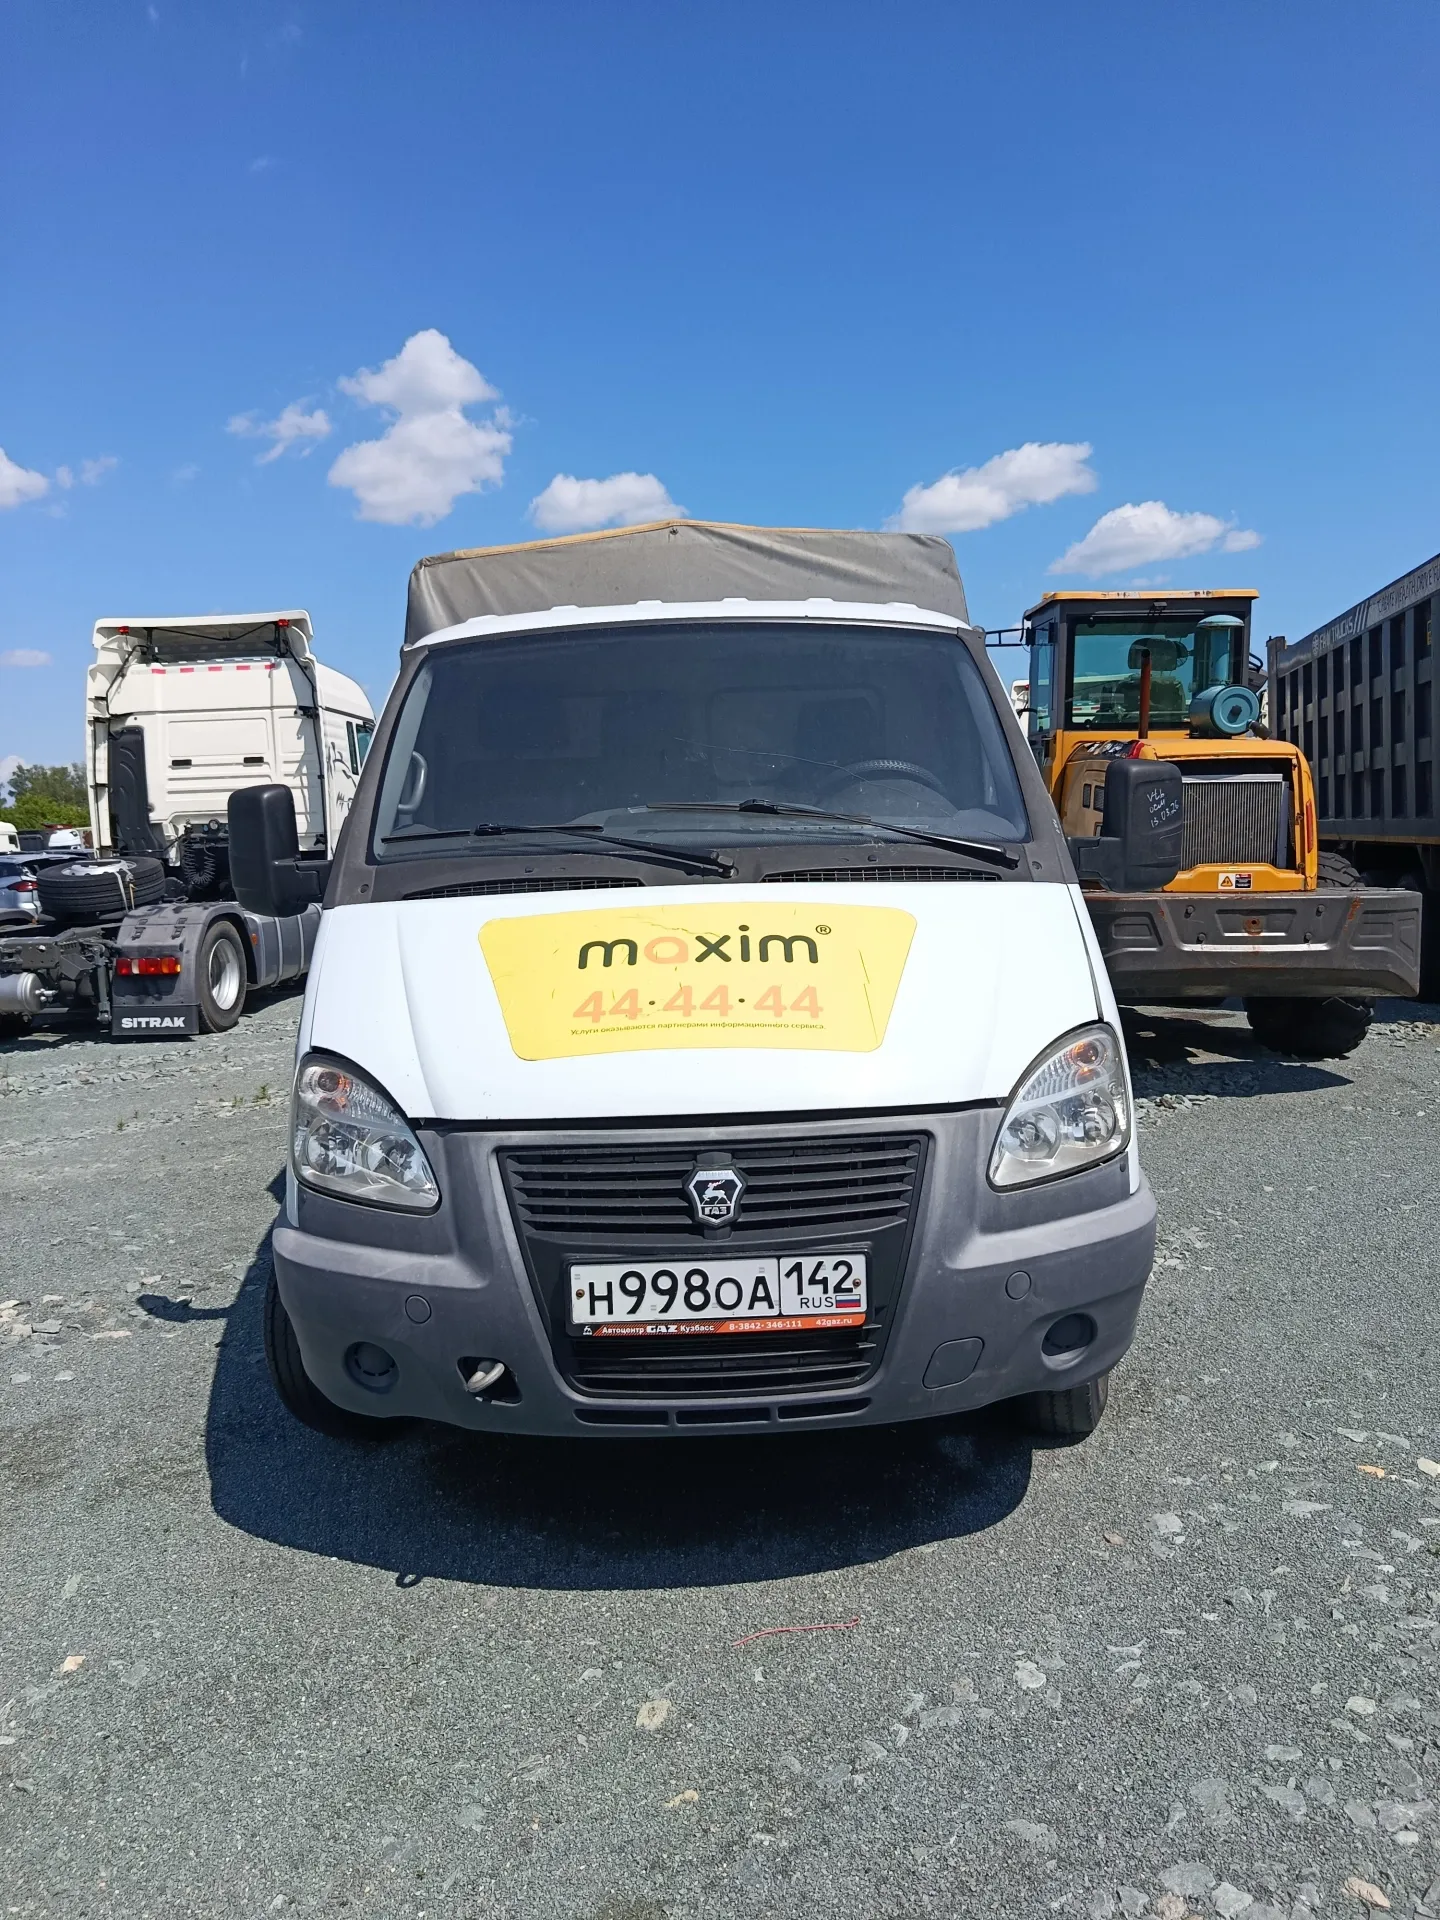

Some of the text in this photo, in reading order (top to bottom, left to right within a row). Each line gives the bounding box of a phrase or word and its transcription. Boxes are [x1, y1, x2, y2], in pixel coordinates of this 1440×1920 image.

[1331, 615, 1354, 643] TRUCKS
[121, 1017, 186, 1028] SITRAK
[571, 1028, 599, 1036] Услуги
[600, 1023, 656, 1033] оказываются
[657, 1021, 708, 1029] партнерами
[710, 1021, 790, 1029] информационного
[704, 1206, 727, 1215] ГАЗ
[784, 1259, 854, 1296] 142
[800, 1296, 834, 1309] RUS
[601, 1326, 645, 1335] Автоцентр
[646, 1325, 678, 1333] GAZ
[680, 1324, 715, 1333] Кузбасс
[815, 1318, 853, 1327] 42gaz.ru
